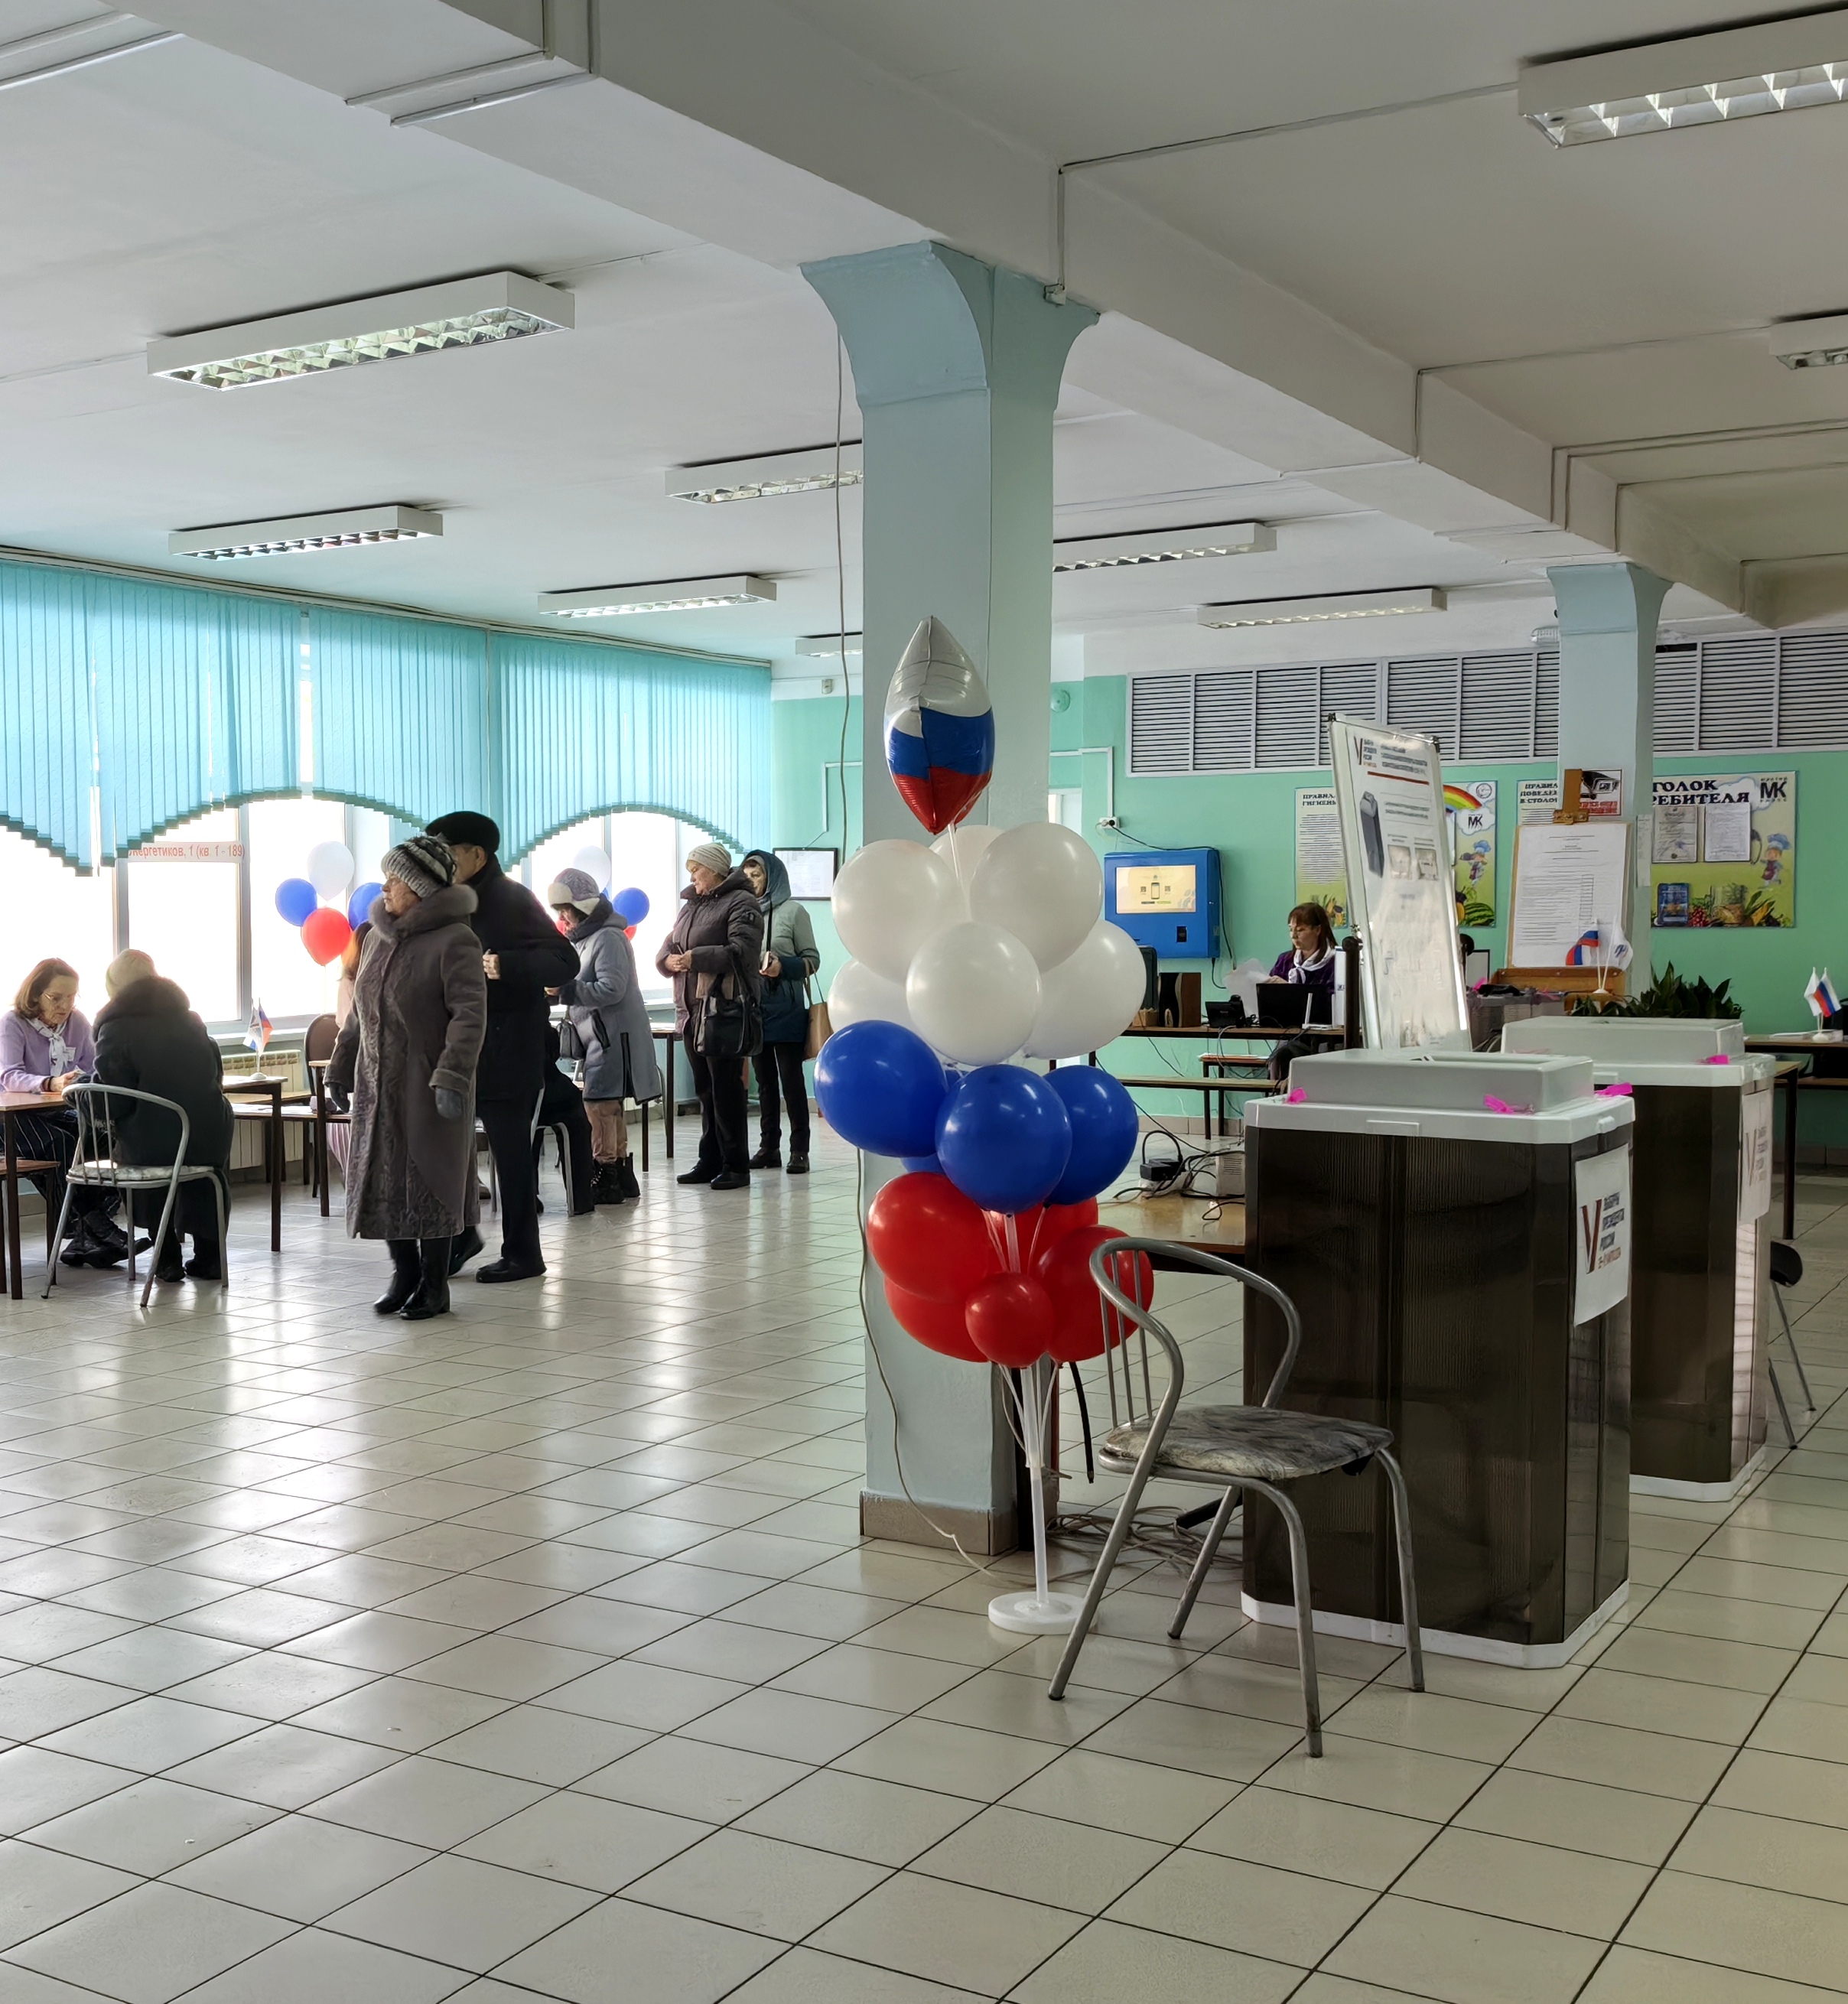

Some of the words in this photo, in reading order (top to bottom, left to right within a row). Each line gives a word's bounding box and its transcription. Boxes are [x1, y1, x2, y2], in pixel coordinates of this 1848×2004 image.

[1652, 779, 1718, 792] ГОЛОК
[189, 844, 194, 857] 1
[214, 844, 220, 857] 1
[228, 844, 246, 860] 189)
